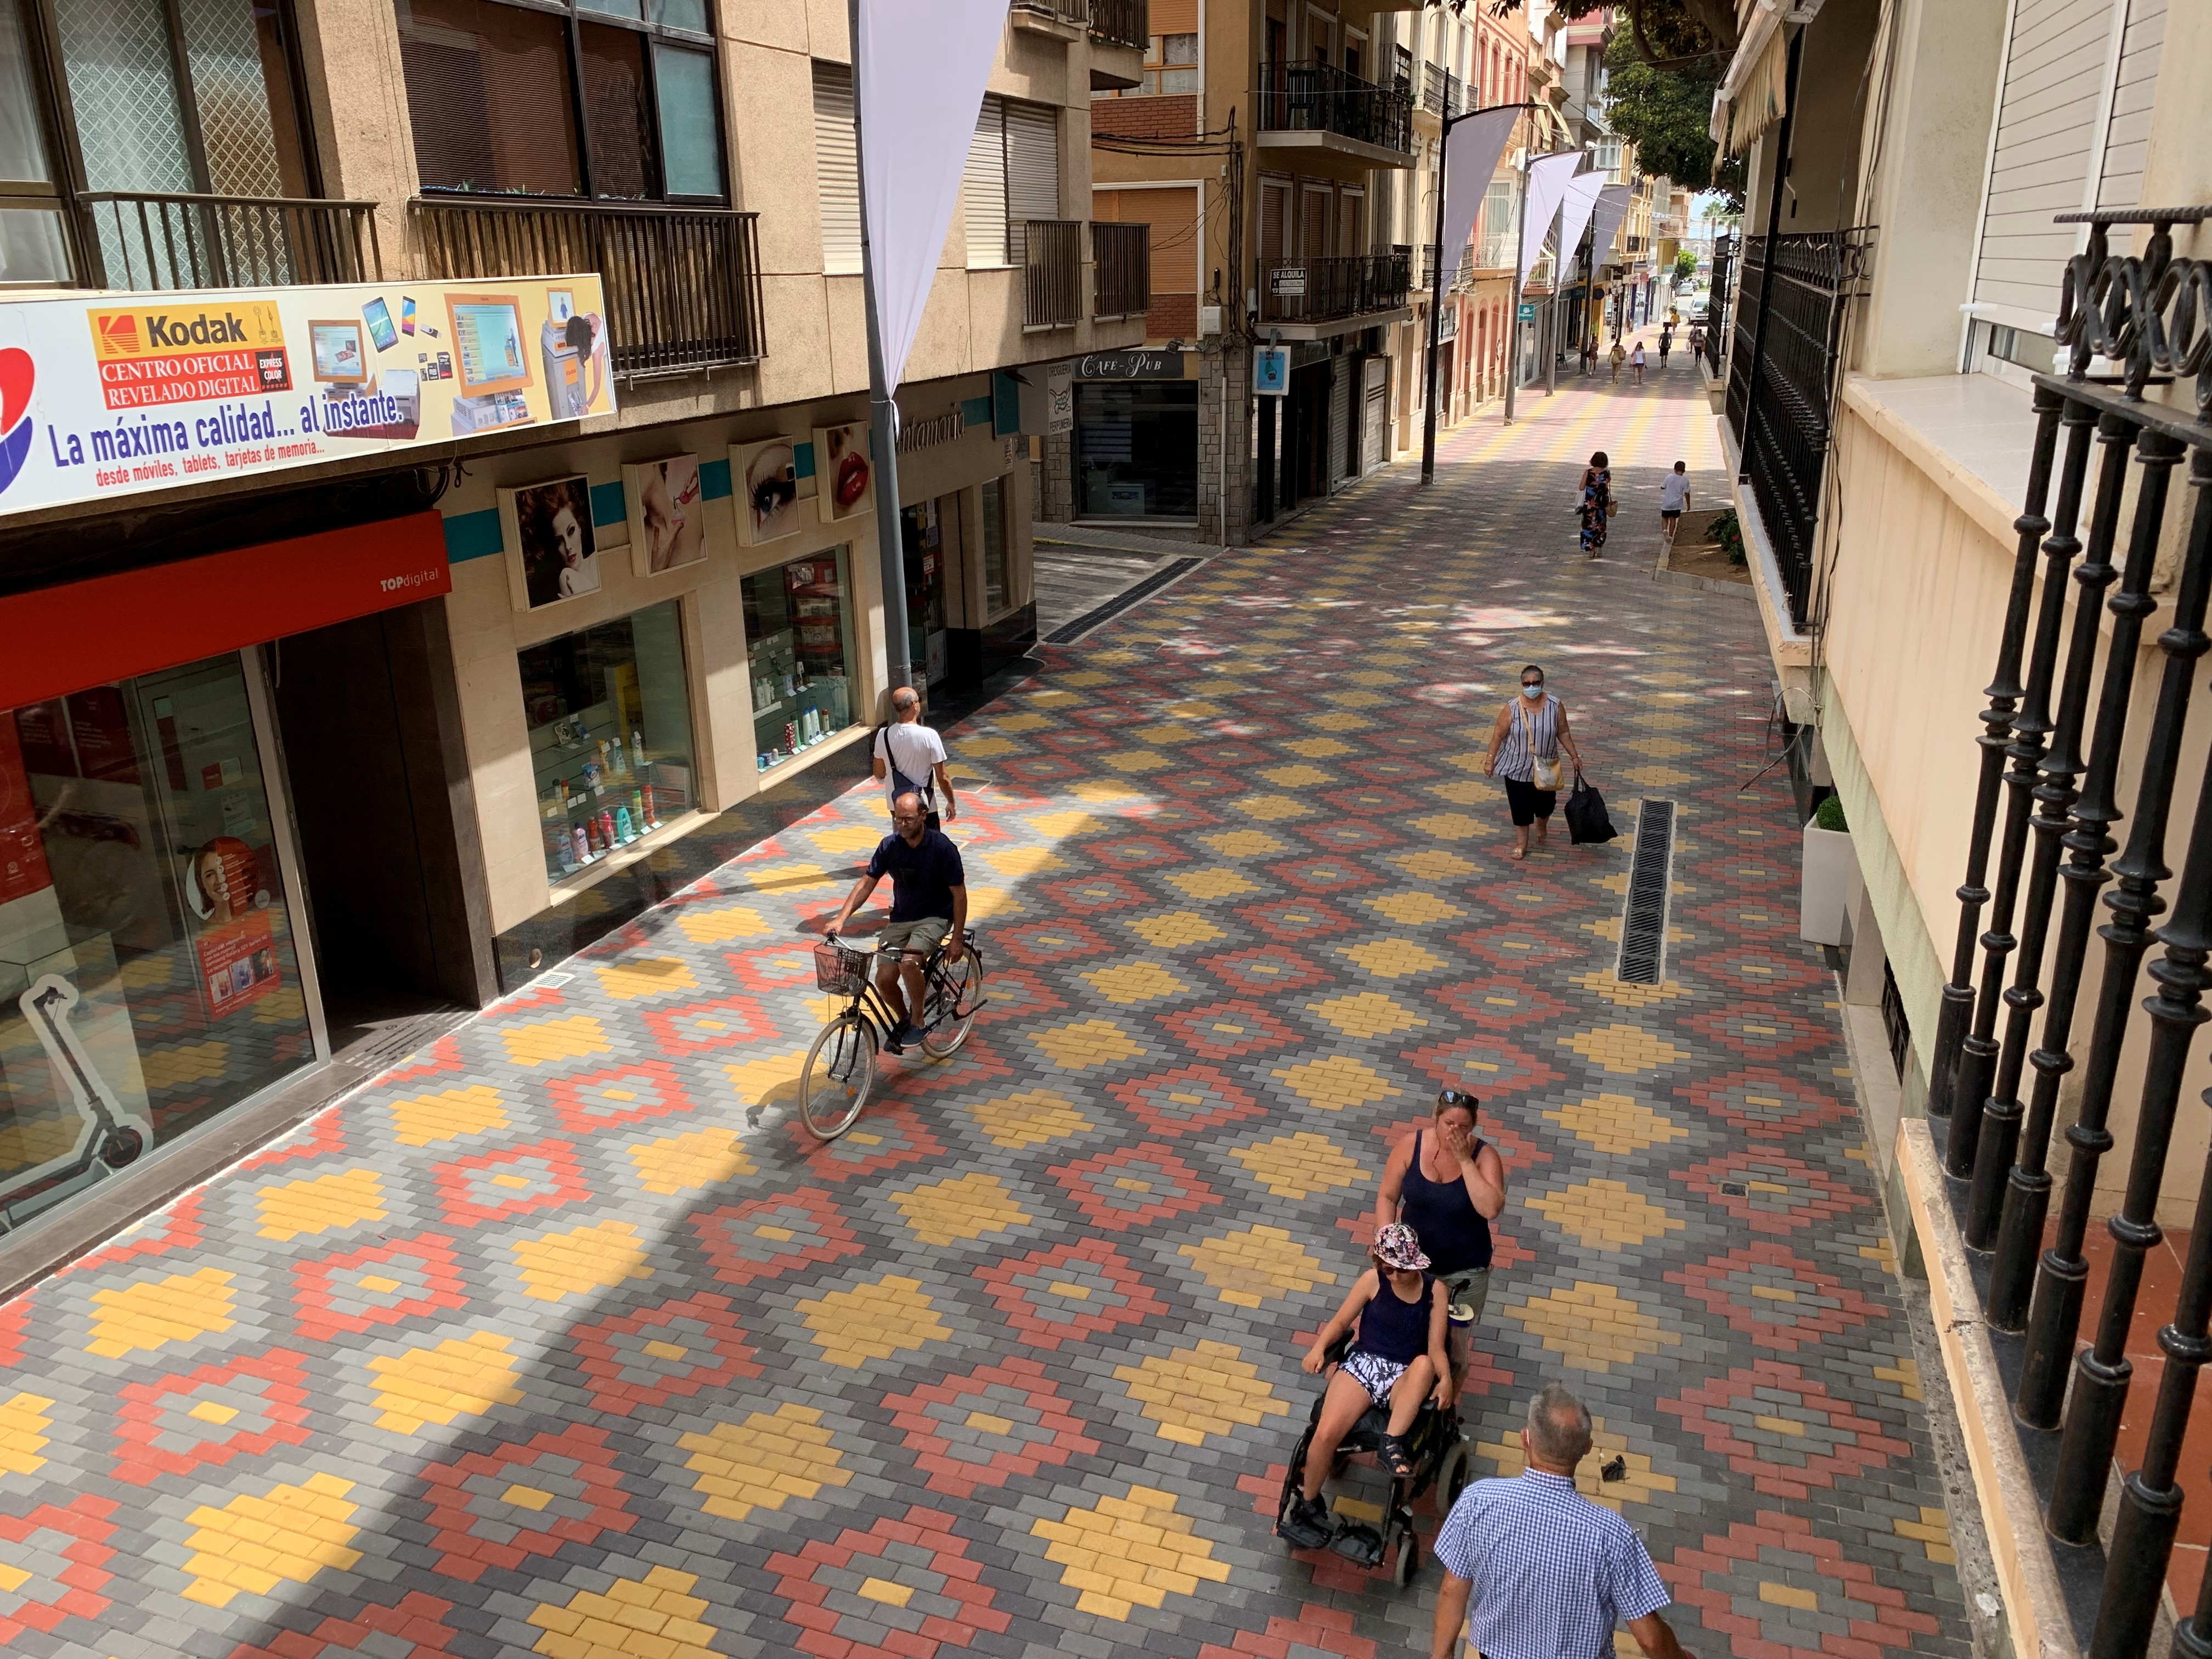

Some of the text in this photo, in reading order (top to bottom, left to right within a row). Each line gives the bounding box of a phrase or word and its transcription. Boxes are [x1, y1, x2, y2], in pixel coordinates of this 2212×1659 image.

[1272, 270, 1305, 279] SE ALQUILA
[146, 313, 248, 347] Kodak
[102, 353, 254, 382] CENTRO OFICIAL
[259, 357, 283, 370] EXPRESS
[264, 369, 282, 380] COLOR
[108, 375, 259, 407] REVELADO DIGITAL
[48, 390, 403, 467] La máxima calidad... al instante.
[95, 438, 325, 487] desde móviles, tablets, tarjetas de memoria...
[380, 568, 439, 592] TOPdigital
[206, 955, 226, 968] Samsung
[225, 947, 241, 958] Galaxy
